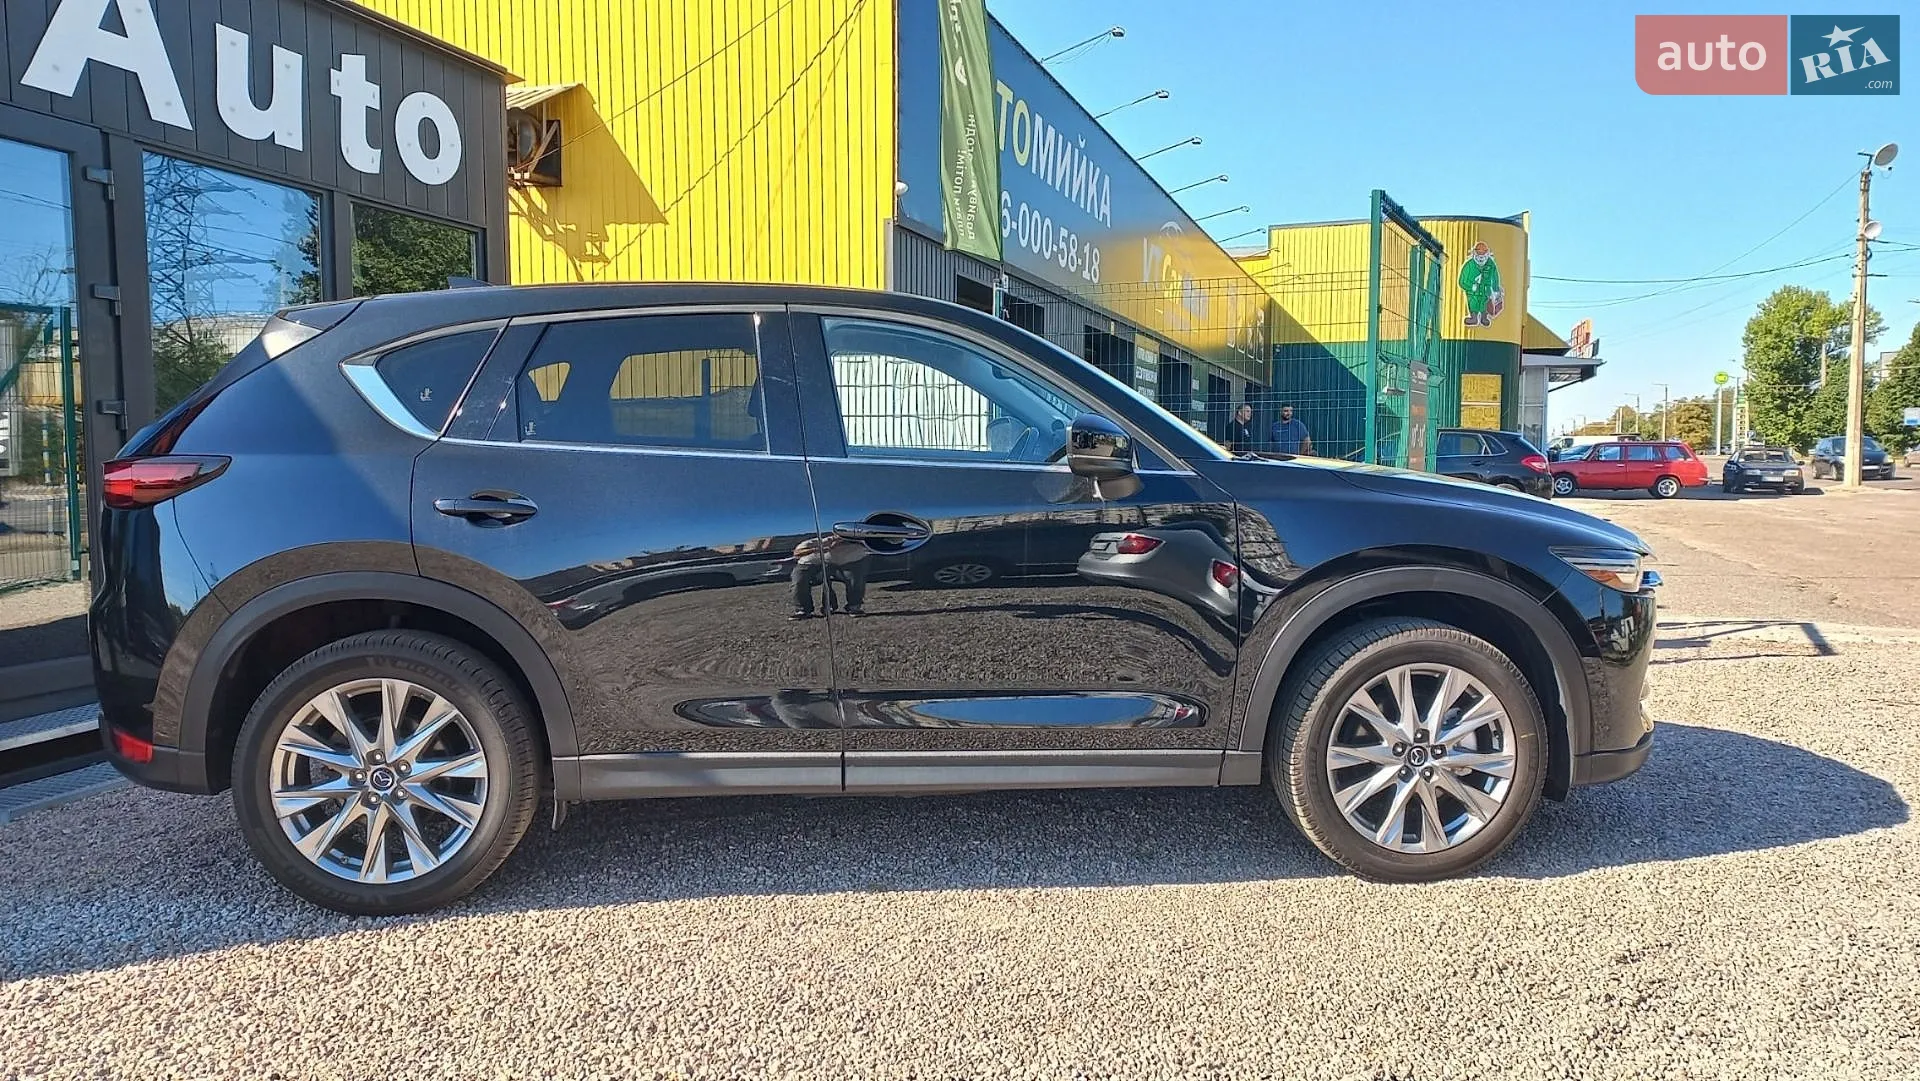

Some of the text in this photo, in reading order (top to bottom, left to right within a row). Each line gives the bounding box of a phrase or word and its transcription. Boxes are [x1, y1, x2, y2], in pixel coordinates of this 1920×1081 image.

[20, 0, 462, 185] Auto
[996, 79, 1112, 229] ТОМИЙКА
[1001, 190, 1100, 284] 6-000-58-18
